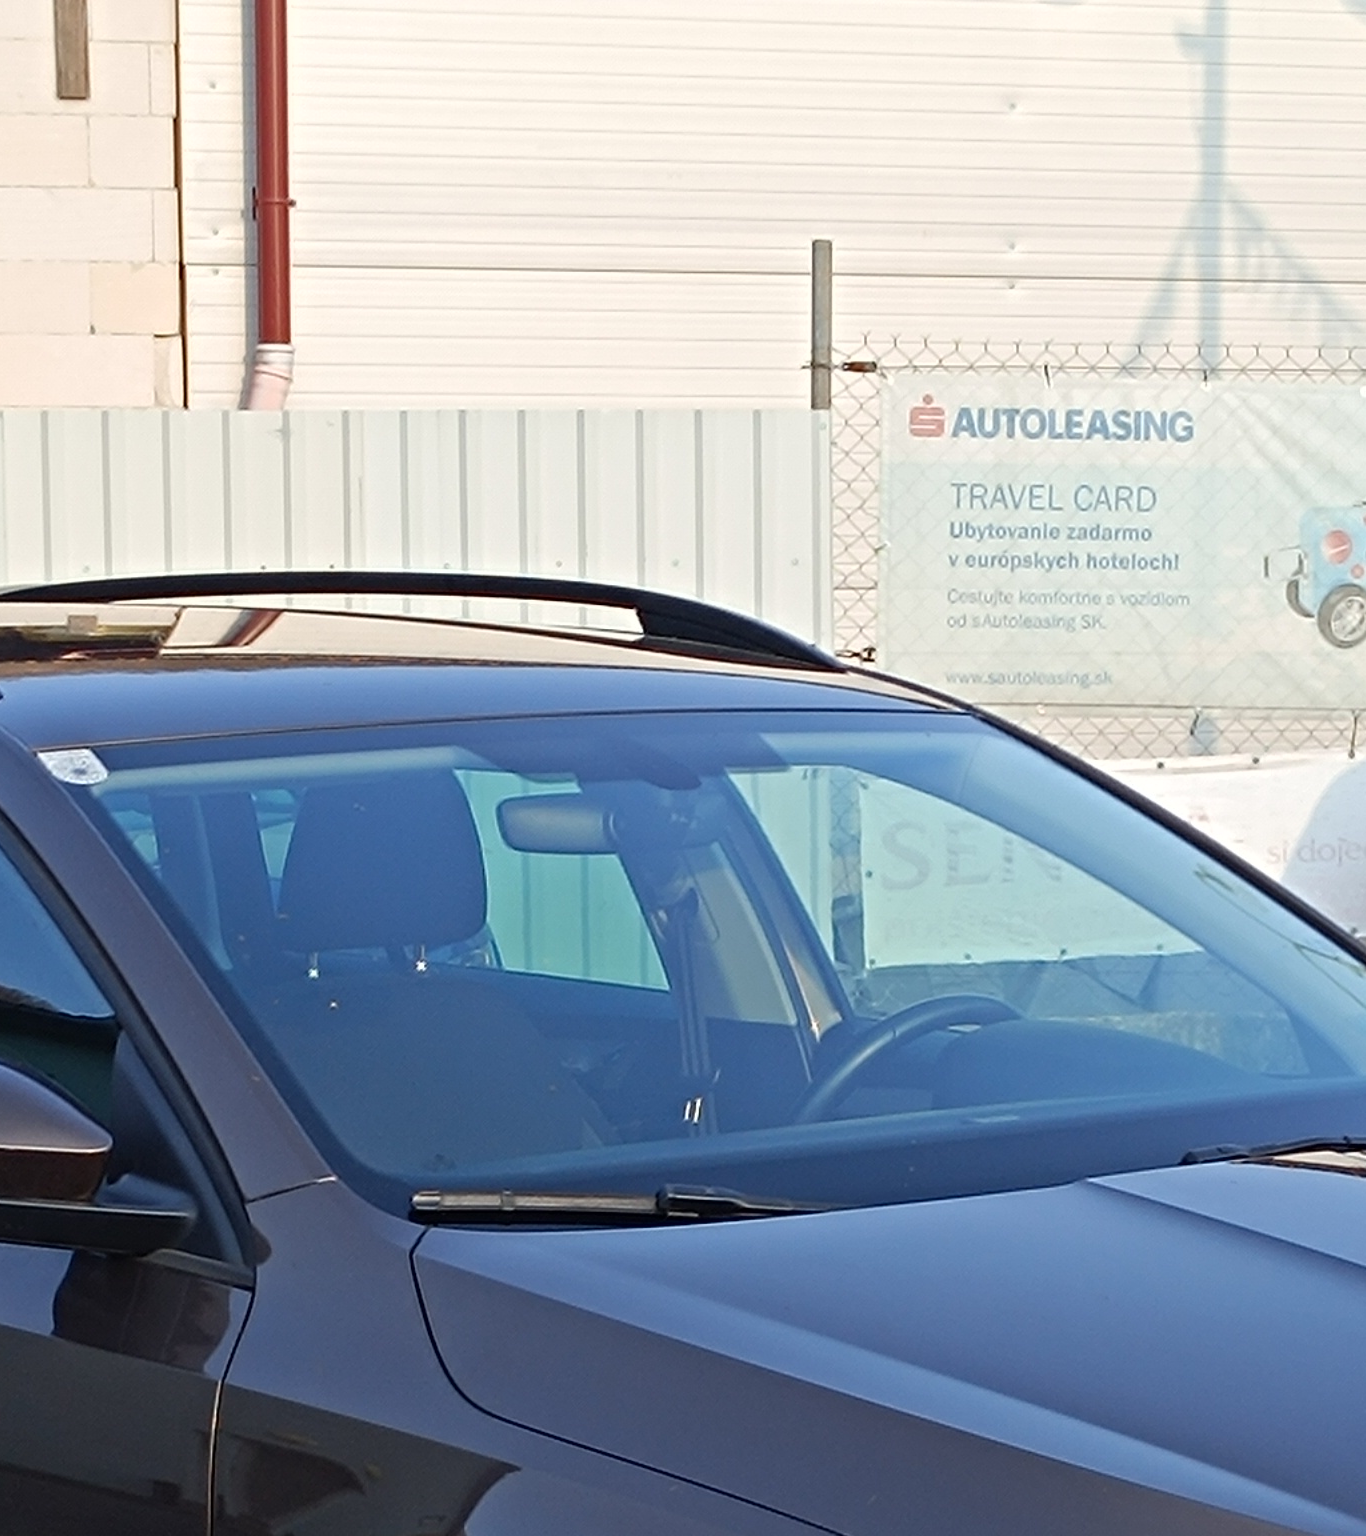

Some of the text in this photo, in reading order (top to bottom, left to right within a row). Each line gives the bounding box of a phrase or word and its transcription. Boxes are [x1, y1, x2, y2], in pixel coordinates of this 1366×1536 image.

[951, 406, 1194, 443] AUTOLEASING
[950, 483, 1158, 513] TRAVEL CARD
[949, 521, 1153, 543] Ubytovanie zadarmo
[947, 550, 1181, 573] v európskych hoteloch!
[1019, 588, 1102, 606] komfortne
[1119, 590, 1191, 607] vozidlom
[946, 613, 967, 629] od
